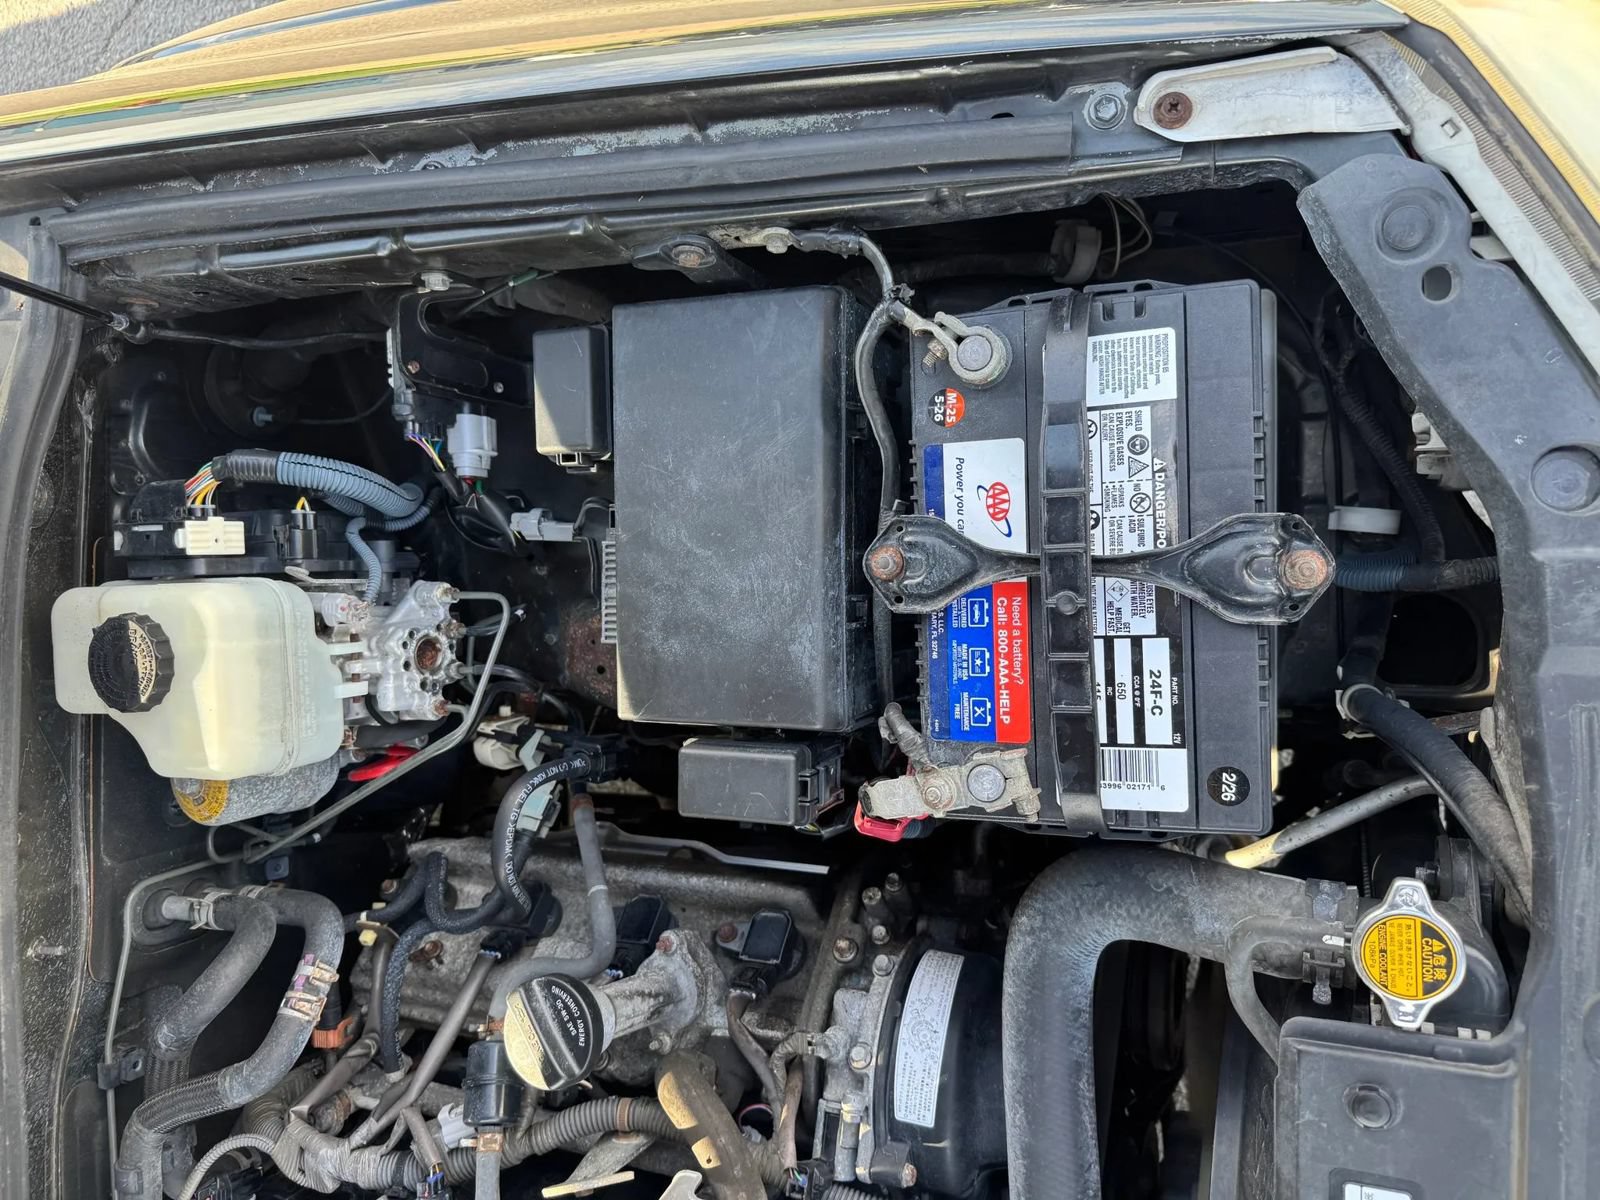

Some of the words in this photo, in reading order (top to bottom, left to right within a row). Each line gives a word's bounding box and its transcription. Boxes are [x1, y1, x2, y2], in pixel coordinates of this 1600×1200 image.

[1161, 334, 1169, 366] PROPOSITION
[934, 395, 944, 422] 5-26
[946, 392, 957, 423] M-25
[1101, 413, 1108, 421] OR
[1125, 411, 1133, 429] EYES.
[1134, 410, 1143, 431] SHIELD
[1108, 424, 1116, 442] CAUSE
[1116, 412, 1124, 445] EXPLOSIVE
[1116, 446, 1124, 465] GASES
[955, 457, 964, 490] Power
[1133, 483, 1141, 492] NO
[954, 495, 963, 515] you
[987, 486, 1010, 518] AAA
[1109, 520, 1115, 528] OR
[1128, 518, 1136, 533] ACID
[1137, 518, 1146, 547] SULFURIC
[997, 597, 1008, 625] Call:
[1012, 597, 1022, 625] Need
[1138, 582, 1146, 619] MMEDIATELY
[1146, 599, 1154, 614] EYES
[930, 612, 938, 629] ARY,
[931, 631, 938, 639] FL
[1011, 640, 1024, 684] battery?
[997, 630, 1010, 724] 800-AAA-HELP
[1106, 686, 1112, 695] RC
[1116, 682, 1126, 700] 650
[1149, 669, 1163, 716] 24F-C
[962, 692, 970, 731] MAINTENANCE
[1173, 732, 1181, 744] 12V
[515, 784, 533, 804] FUEL
[1221, 772, 1237, 801] 2/26
[510, 807, 521, 820] TG
[504, 861, 513, 875] DO
[1378, 925, 1387, 950] ENGINE
[1369, 941, 1377, 968] 108kPa
[1422, 938, 1433, 982] CAUTION
[1433, 954, 1447, 981] 危険
[1379, 952, 1388, 985] COOLANT
[551, 985, 580, 1017] CONSERVING
[555, 999, 570, 1022] 5W-30
[566, 1021, 577, 1036] SAE
[576, 1019, 585, 1047] ENERGY
